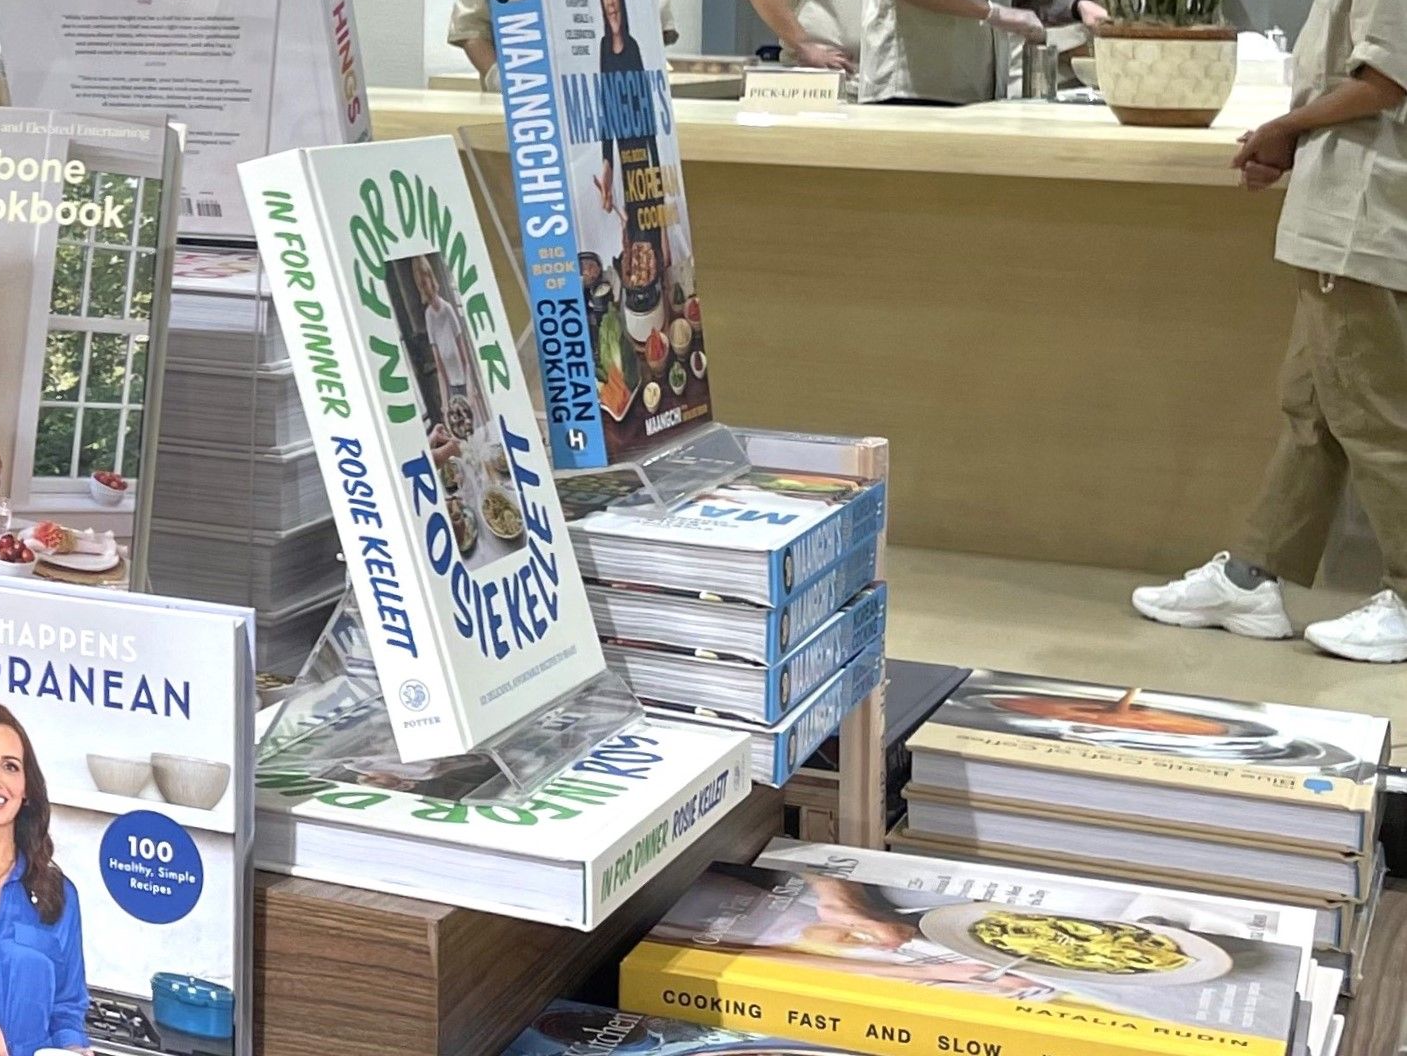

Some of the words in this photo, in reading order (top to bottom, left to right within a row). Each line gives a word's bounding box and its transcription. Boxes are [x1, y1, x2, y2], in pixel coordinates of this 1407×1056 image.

[497, 10, 569, 238] MAANGCHI'S
[561, 69, 672, 145] MAANGCHI'S
[749, 87, 799, 99] PICK-UP
[802, 88, 835, 100] HERE
[0, 120, 24, 134] and
[76, 125, 153, 141] Entertaining
[262, 189, 296, 229] IN
[273, 230, 316, 292] FOR
[350, 176, 400, 320] FOR
[531, 260, 576, 276] BOOK
[538, 246, 566, 259] BIG
[389, 168, 512, 394] DINNER
[545, 277, 567, 290] OF
[293, 298, 352, 419] DINNER
[369, 335, 416, 424] IN
[536, 298, 572, 424] COOKING
[557, 297, 596, 422] KOREAN
[330, 434, 382, 529] ROSIE
[400, 450, 509, 661] ROSIE
[363, 530, 419, 658] KELLETT
[403, 715, 442, 729] POTTER
[571, 732, 660, 780] ROS
[127, 835, 174, 863] 100
[600, 865, 614, 904] IN
[613, 848, 633, 893] FOR
[633, 818, 669, 875] DINNER
[671, 794, 698, 843] ROSIE
[697, 769, 730, 820] KELLETT
[109, 857, 155, 878] Healthy,
[157, 866, 196, 885] Simple
[129, 877, 173, 896] Recipes
[662, 989, 763, 1020] COOKING
[787, 1009, 842, 1033] FAST
[865, 1023, 912, 1045] AND
[937, 1034, 1003, 1056] SLOW
[1015, 1005, 1139, 1031] NATALIA
[1153, 1026, 1249, 1048] RUDIN
